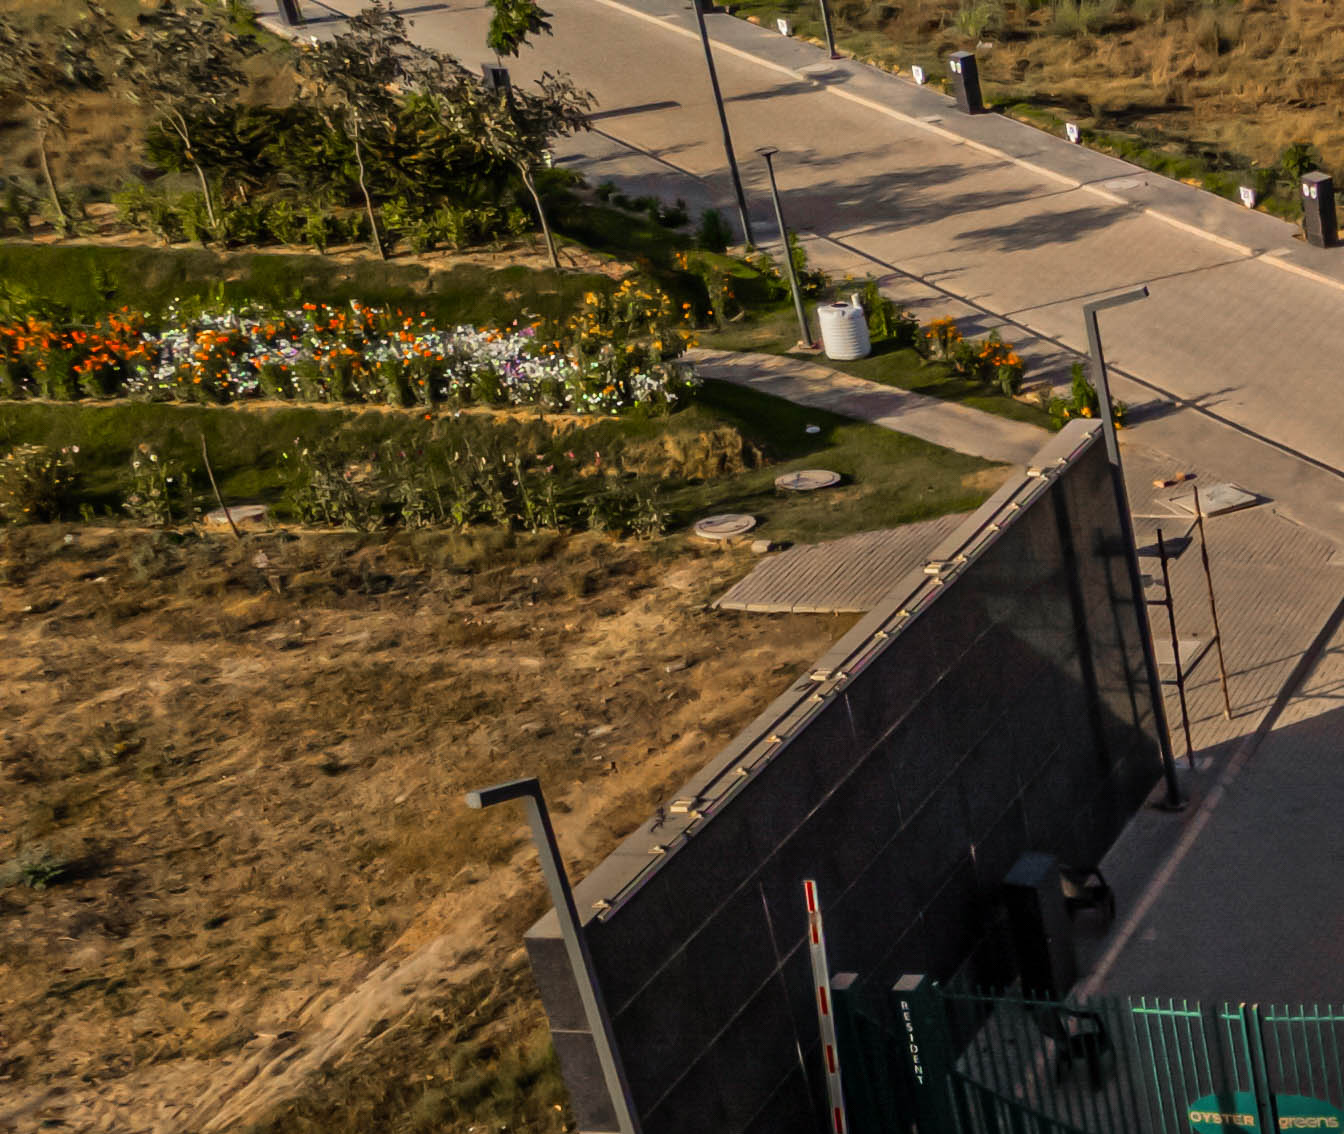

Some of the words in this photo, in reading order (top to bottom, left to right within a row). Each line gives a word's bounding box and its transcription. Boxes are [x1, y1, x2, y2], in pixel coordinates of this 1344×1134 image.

[901, 1001, 923, 1085] RESIDENT
[1189, 1111, 1255, 1126] OYSTER
[1278, 1115, 1340, 1129] greens
